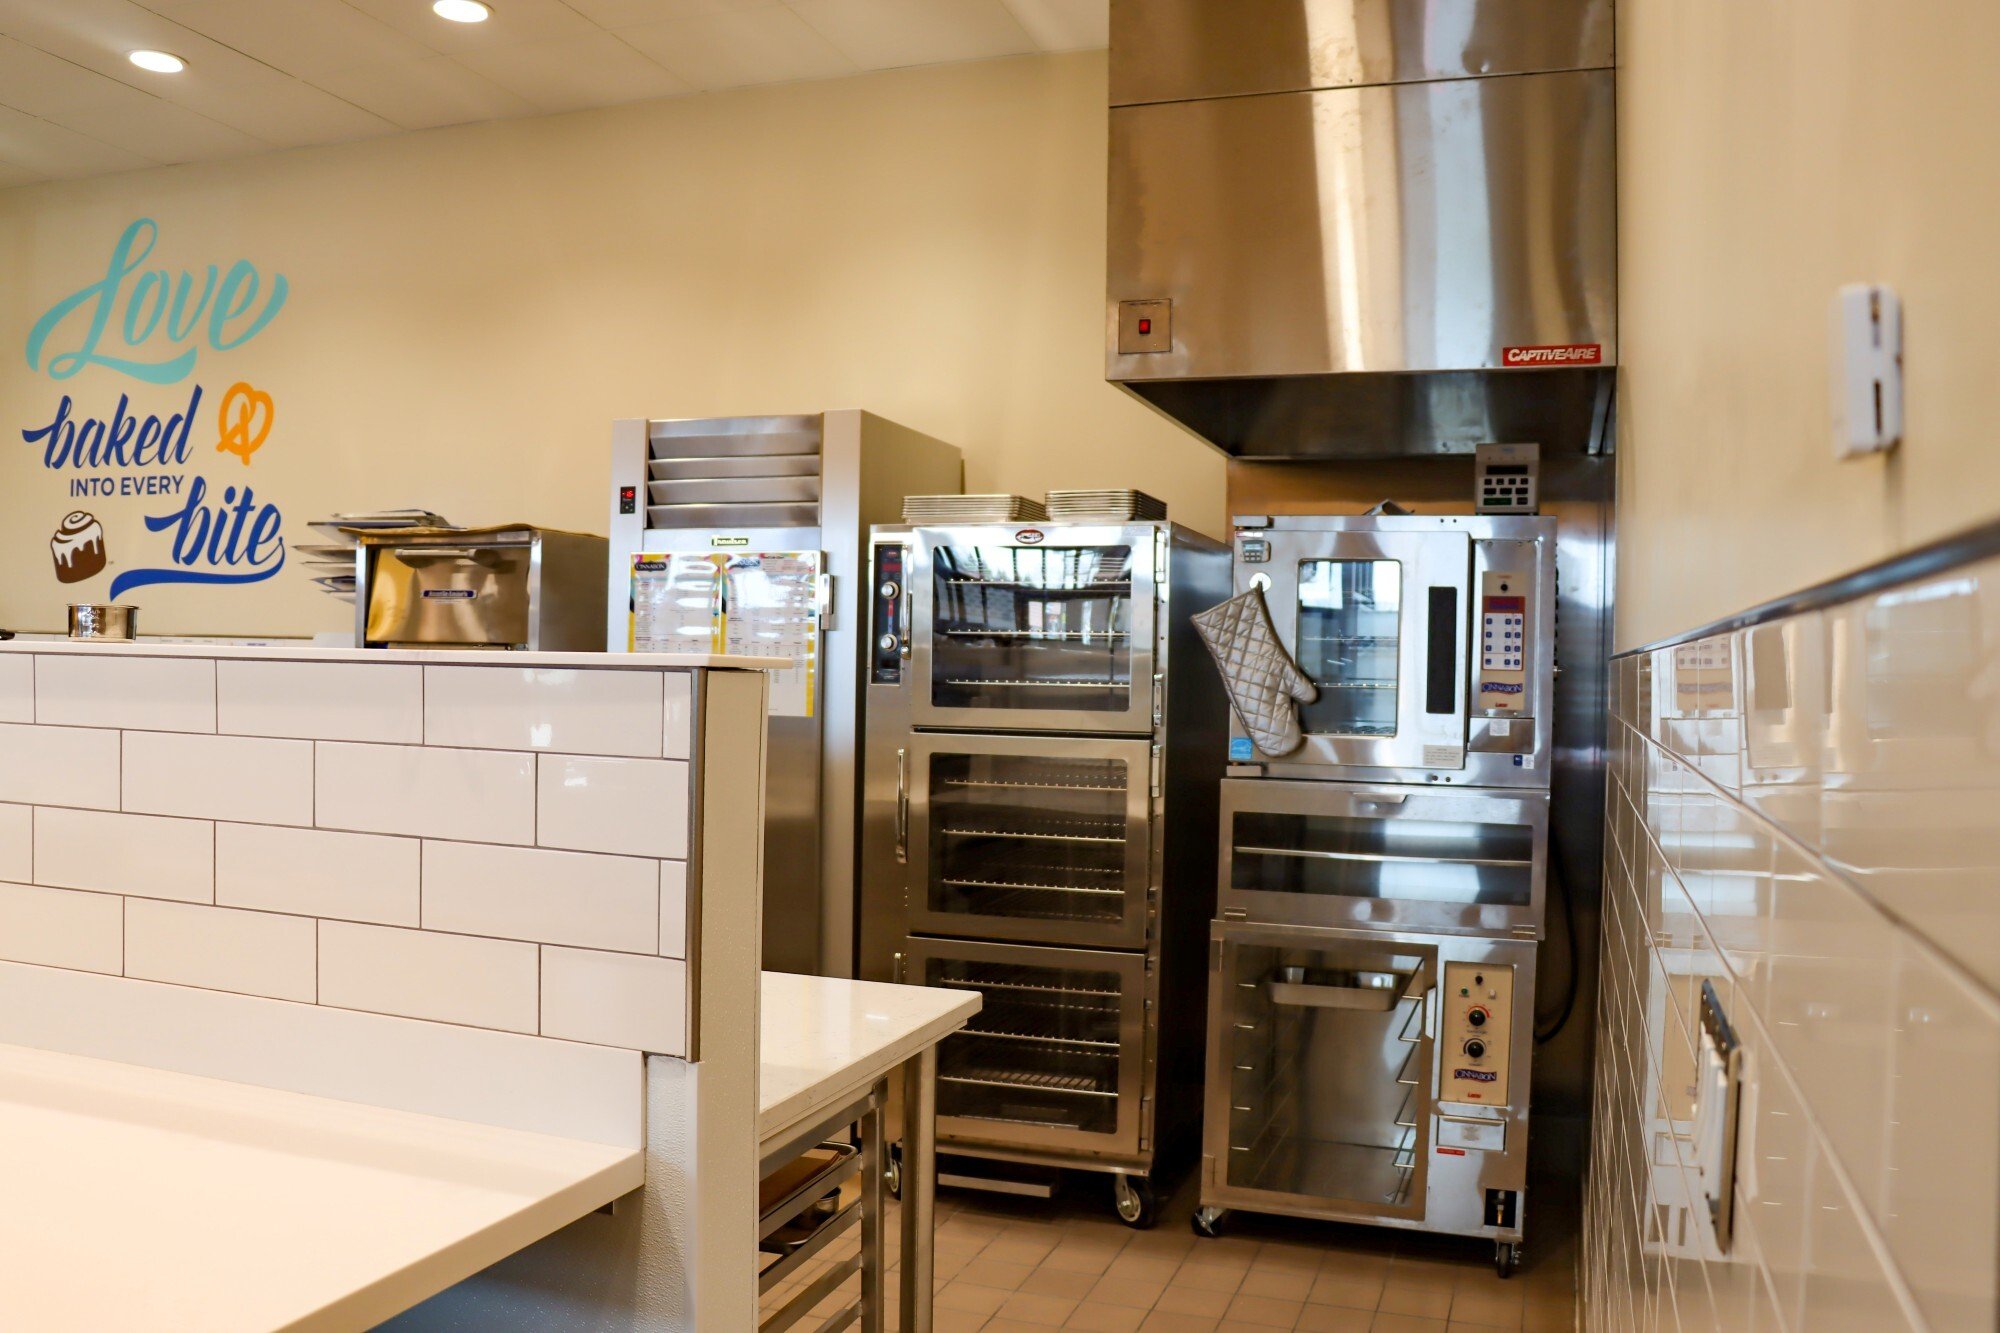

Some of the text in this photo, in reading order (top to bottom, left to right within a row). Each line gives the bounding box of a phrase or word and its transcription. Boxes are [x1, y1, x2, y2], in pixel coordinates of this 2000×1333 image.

[25, 217, 289, 385] Love
[1508, 347, 1597, 361] CAPTIVEAIRE
[22, 384, 203, 469] baked
[70, 475, 184, 497] INTO EVERY
[110, 476, 286, 602] bite
